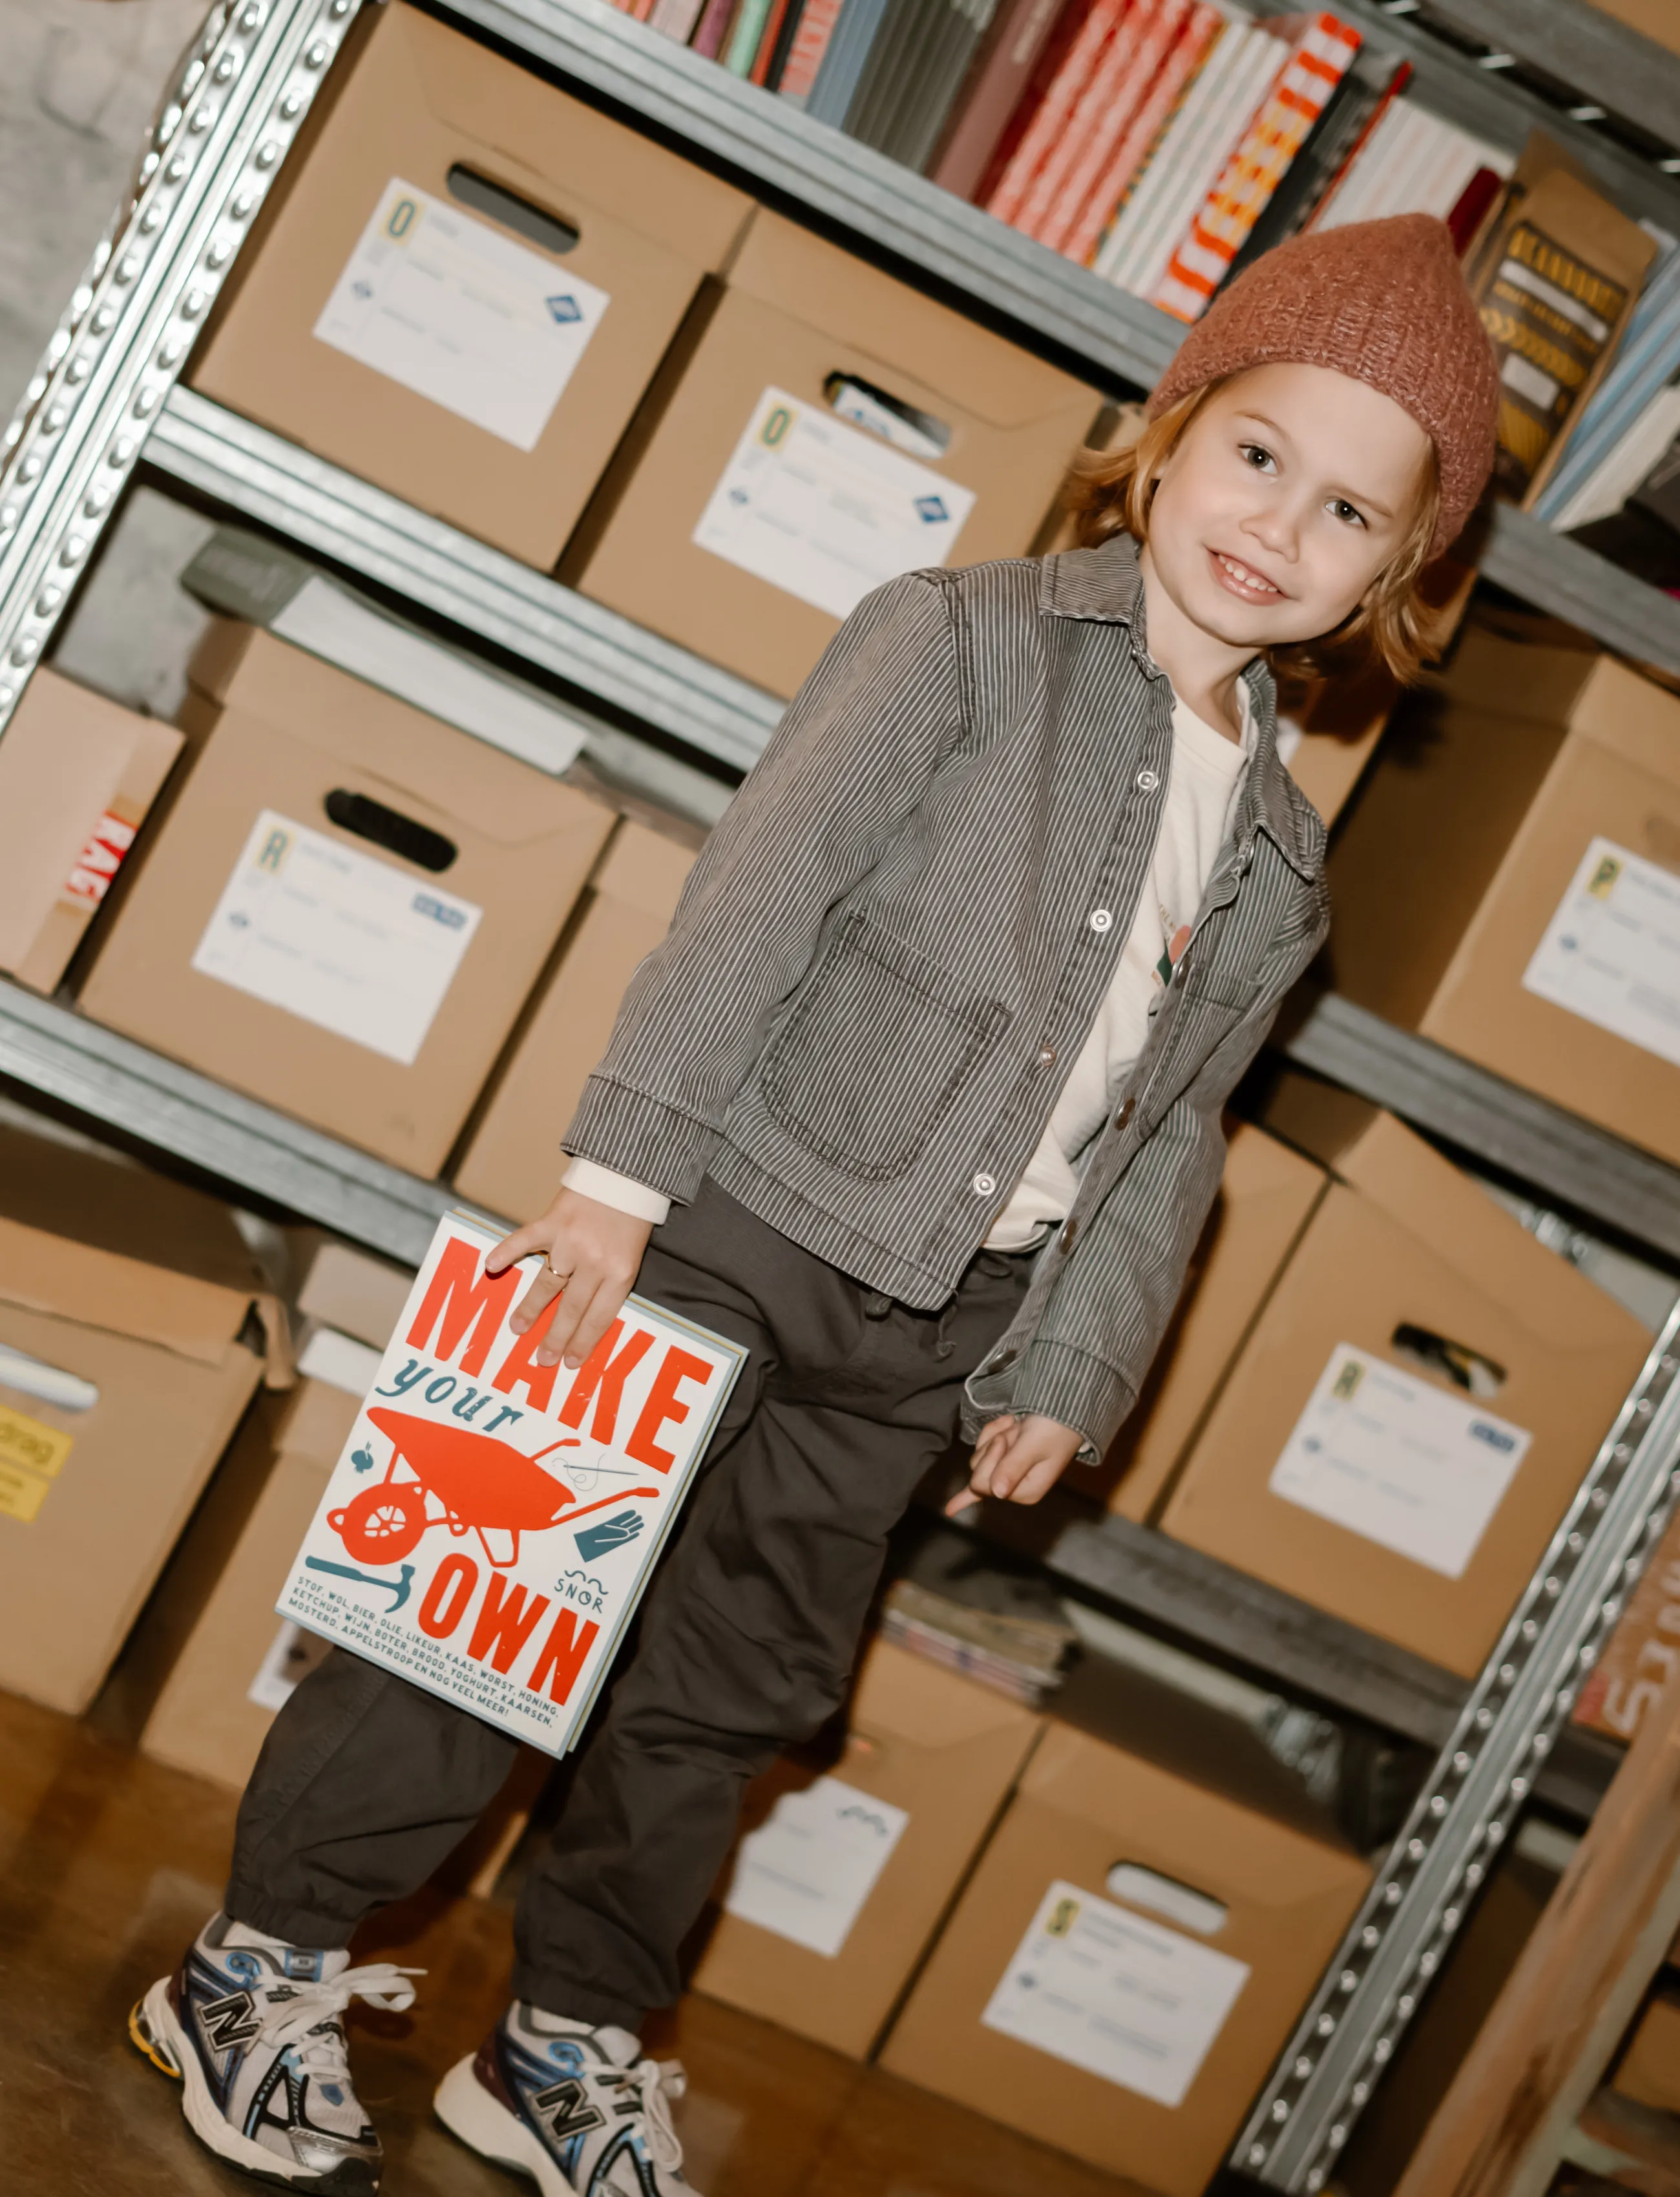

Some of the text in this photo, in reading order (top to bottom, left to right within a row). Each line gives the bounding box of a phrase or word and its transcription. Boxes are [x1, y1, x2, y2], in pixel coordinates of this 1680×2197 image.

[375, 1359, 523, 1432] your
[406, 1237, 713, 1474] MAKE
[419, 1553, 600, 1706] OWN
[555, 1578, 604, 1614] SNOR
[341, 1624, 414, 1666] APPELSTROOP
[414, 1662, 428, 1674] EN
[428, 1669, 450, 1686] NOG
[450, 1681, 476, 1699] VEEL
[476, 1694, 510, 1716] MEER!
